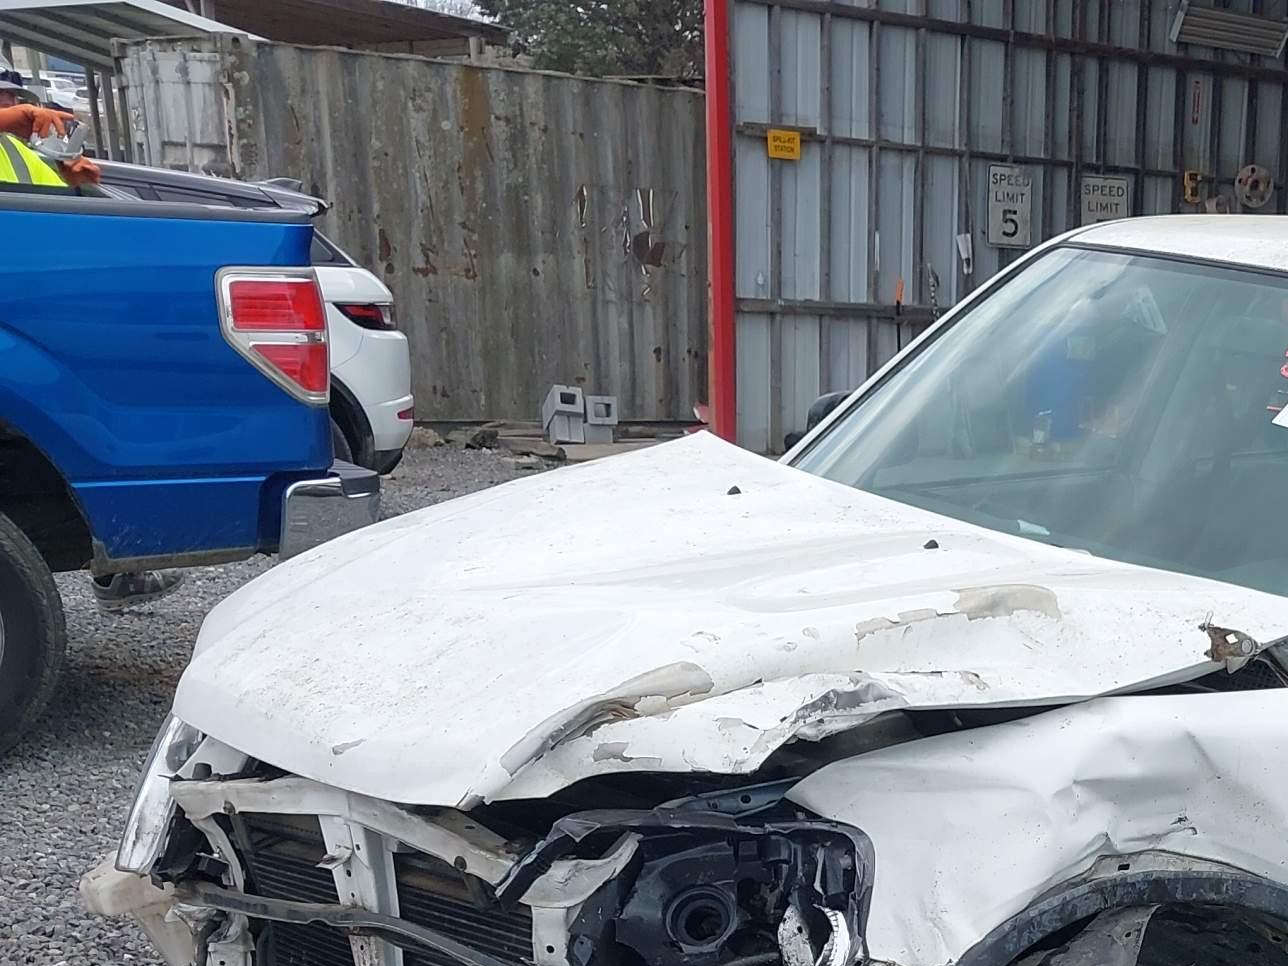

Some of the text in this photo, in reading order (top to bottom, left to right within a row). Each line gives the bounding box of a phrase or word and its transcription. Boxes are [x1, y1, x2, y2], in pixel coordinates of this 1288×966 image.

[991, 172, 1030, 188] SPEED
[994, 191, 1026, 205] LIMIT
[1083, 183, 1126, 198] SPEED
[1087, 201, 1121, 214] LIMIT
[1001, 208, 1019, 238] 5
